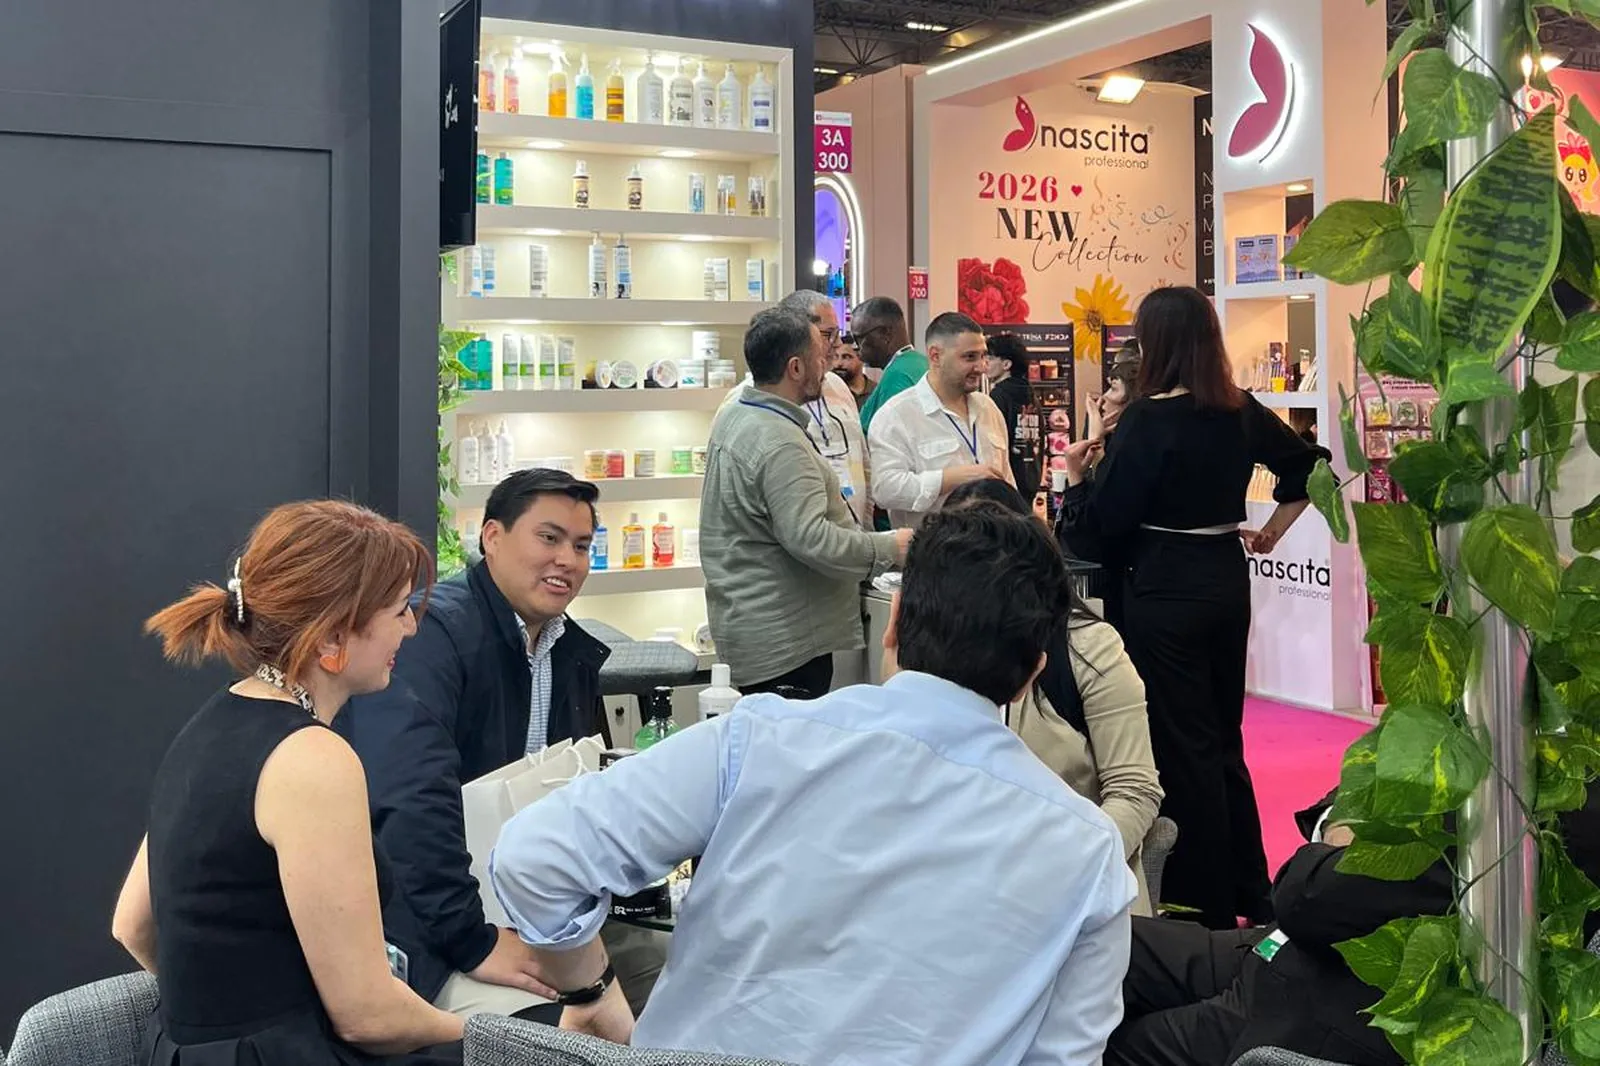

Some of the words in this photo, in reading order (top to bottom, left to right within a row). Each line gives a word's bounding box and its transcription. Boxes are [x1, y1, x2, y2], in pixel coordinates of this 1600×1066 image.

[821, 128, 845, 146] 3A
[1041, 124, 1149, 154] nascita
[818, 151, 849, 169] 300
[1084, 155, 1149, 169] professional
[978, 171, 1058, 203] 2026
[995, 207, 1082, 242] NEW
[1033, 231, 1149, 272] Collection
[910, 287, 927, 298] 700
[1247, 557, 1331, 587] nascita
[1279, 585, 1331, 600] professional
